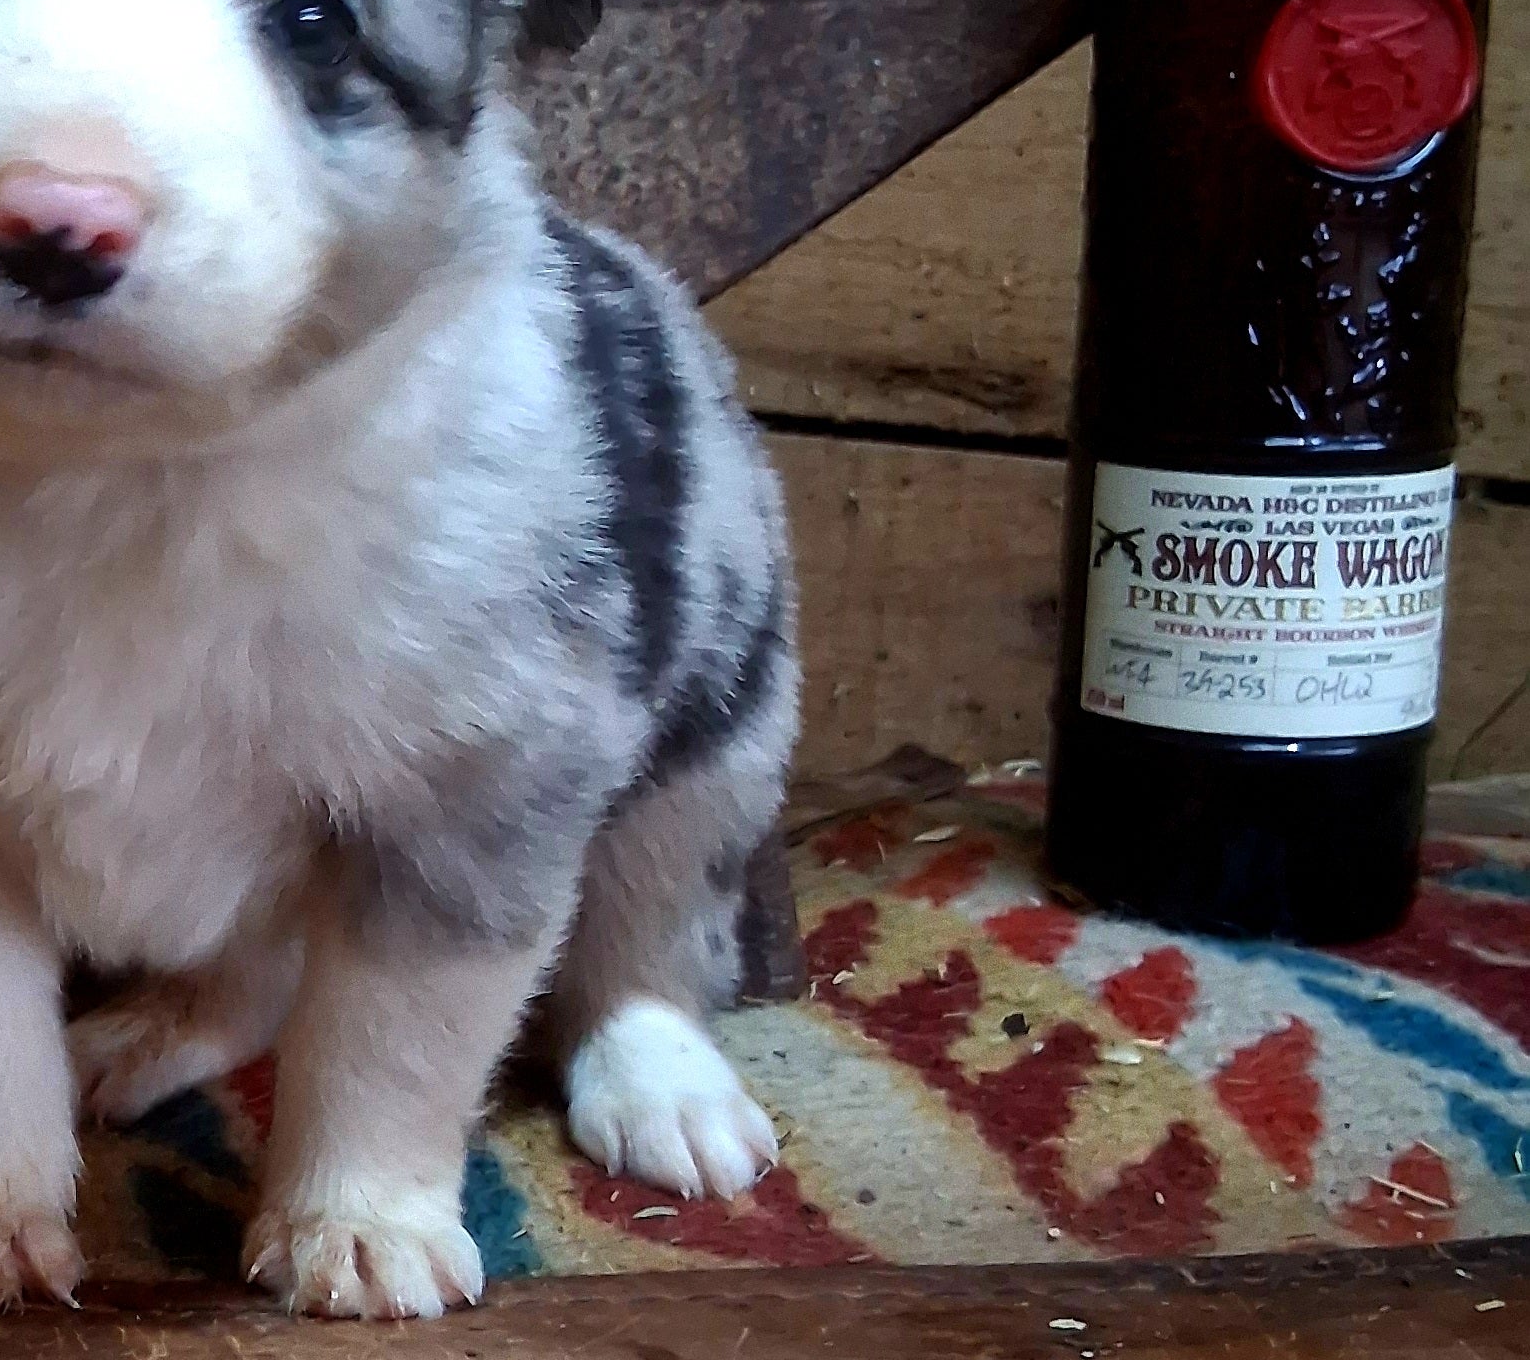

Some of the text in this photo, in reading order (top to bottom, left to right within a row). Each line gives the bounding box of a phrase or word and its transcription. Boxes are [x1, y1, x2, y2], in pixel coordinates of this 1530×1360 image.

[1151, 488, 1254, 514] NEVADA
[1266, 518, 1395, 536] LAS VEGAS
[1151, 532, 1318, 589] SMOKE
[1125, 585, 1326, 622] PRIVATE
[1153, 620, 1267, 642] STRAIGHT
